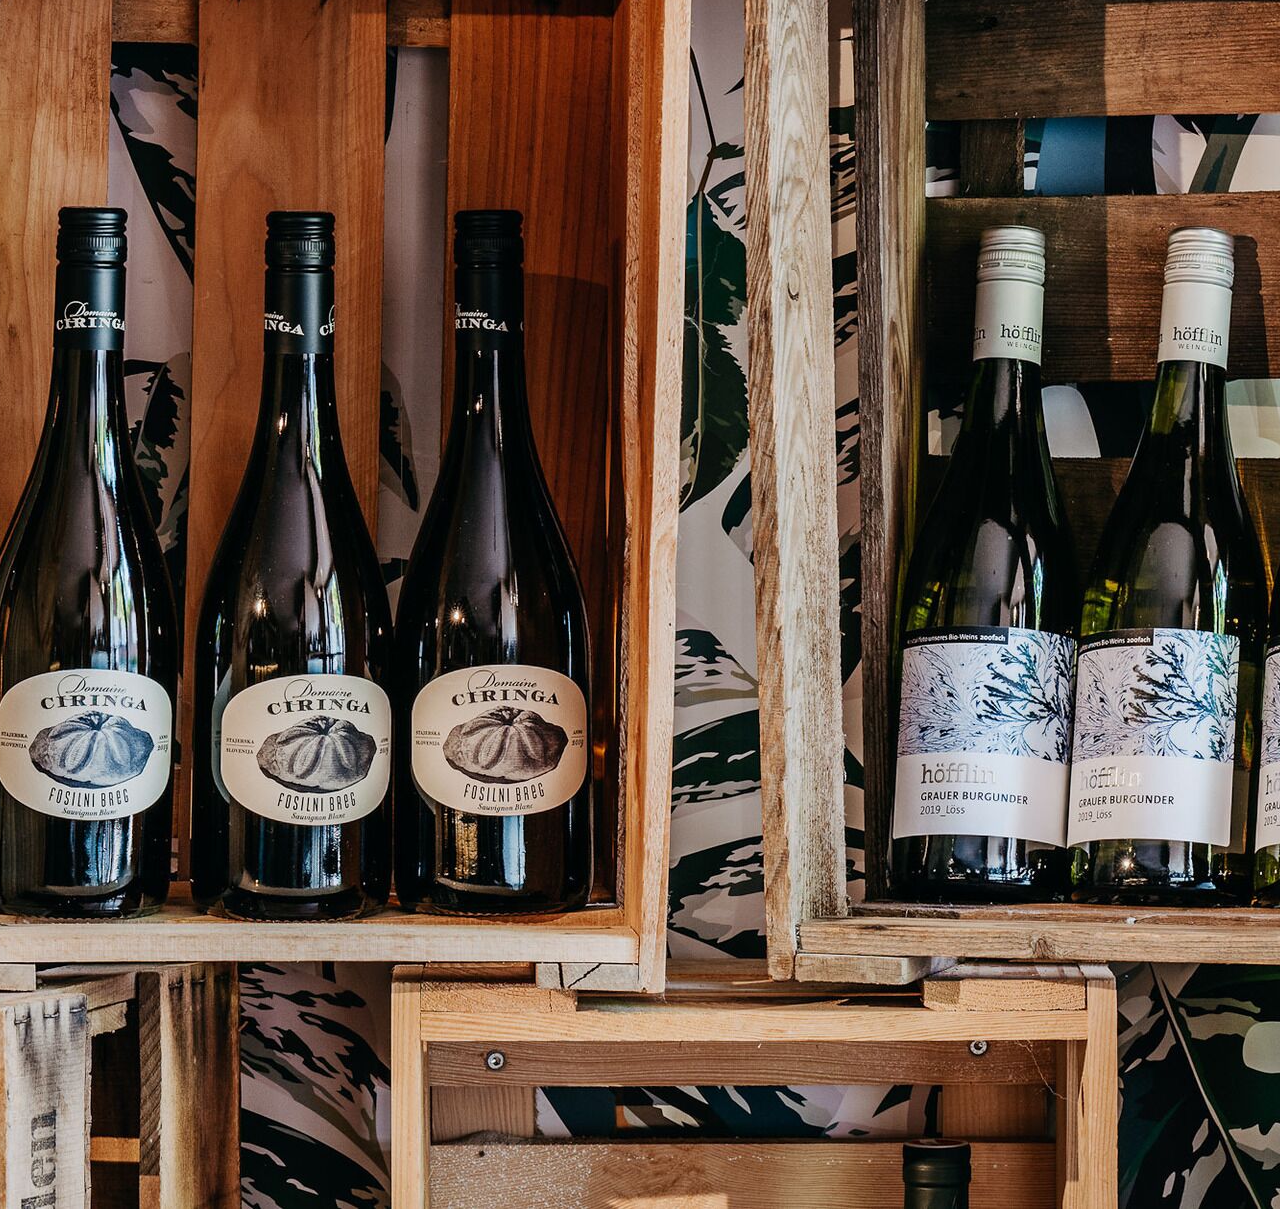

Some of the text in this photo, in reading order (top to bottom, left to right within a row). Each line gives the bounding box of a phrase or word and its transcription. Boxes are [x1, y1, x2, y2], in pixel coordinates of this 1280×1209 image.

[64, 300, 118, 318] Domaine
[1172, 326, 1223, 347] höfflin
[1178, 343, 1218, 354] WEINGUT
[949, 633, 978, 641] Bio-Weins
[57, 674, 127, 700] Domaine
[467, 669, 538, 693] Domaine
[284, 678, 352, 704] Domaine
[451, 689, 560, 706] CIRINGA
[40, 694, 148, 712] CIRINGA
[267, 698, 371, 716] CIRINGA
[920, 762, 997, 785] höfflin
[1079, 766, 1143, 791] höfflin
[48, 787, 95, 808] FOSILNI
[464, 783, 510, 802] FOSILNI
[920, 791, 1028, 805] GRAUER BURGUNDER
[1078, 794, 1175, 808] GRAUER BURGUNDER
[277, 792, 324, 812] FOSILNI
[477, 803, 534, 813] Sauvignon Blanc
[919, 805, 965, 817] 2019_Löss
[61, 807, 117, 818] Sauvignon Blanc
[291, 812, 346, 822] Sauvignon Blanc
